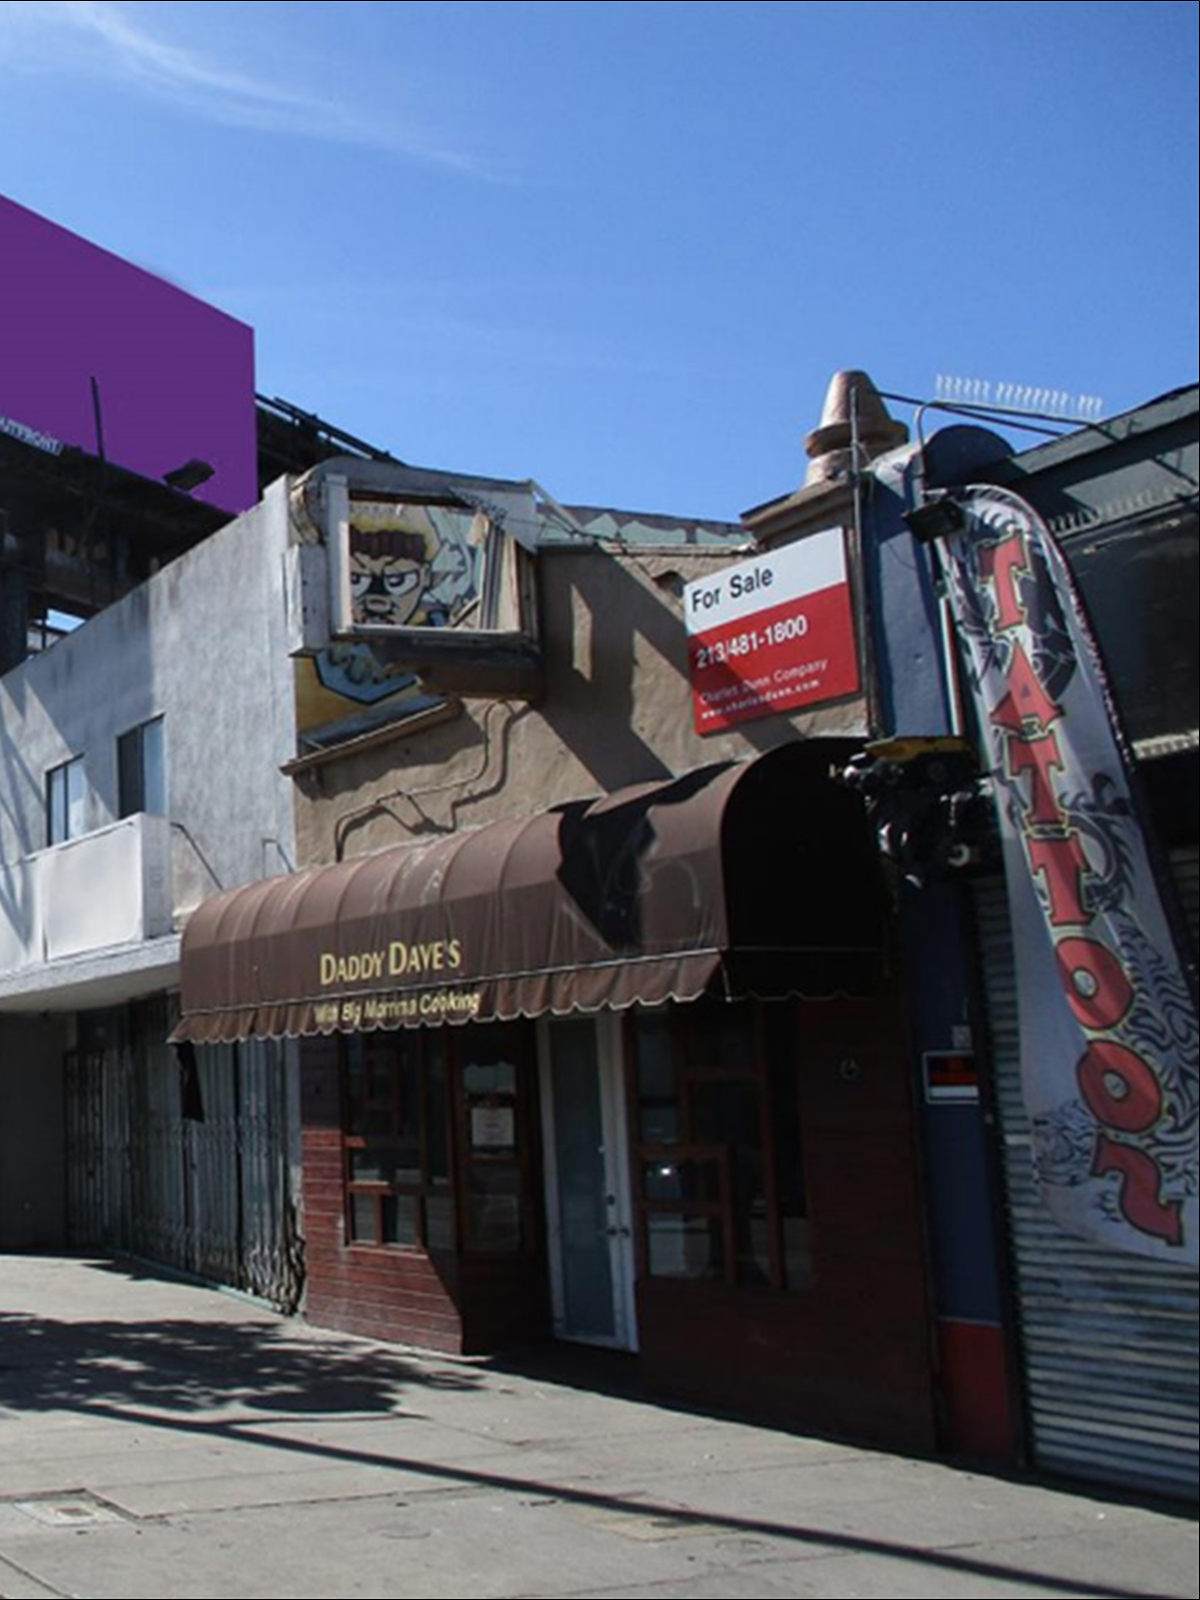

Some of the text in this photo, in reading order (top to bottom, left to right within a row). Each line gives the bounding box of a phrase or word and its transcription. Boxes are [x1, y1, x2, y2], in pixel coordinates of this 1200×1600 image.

[691, 567, 774, 613] For Sale
[696, 614, 808, 669] 213/481-1800
[773, 659, 828, 683] Company
[320, 939, 462, 985] DADDY DAVE'S
[341, 1002, 362, 1025] Big
[419, 990, 481, 1015] Cooking
